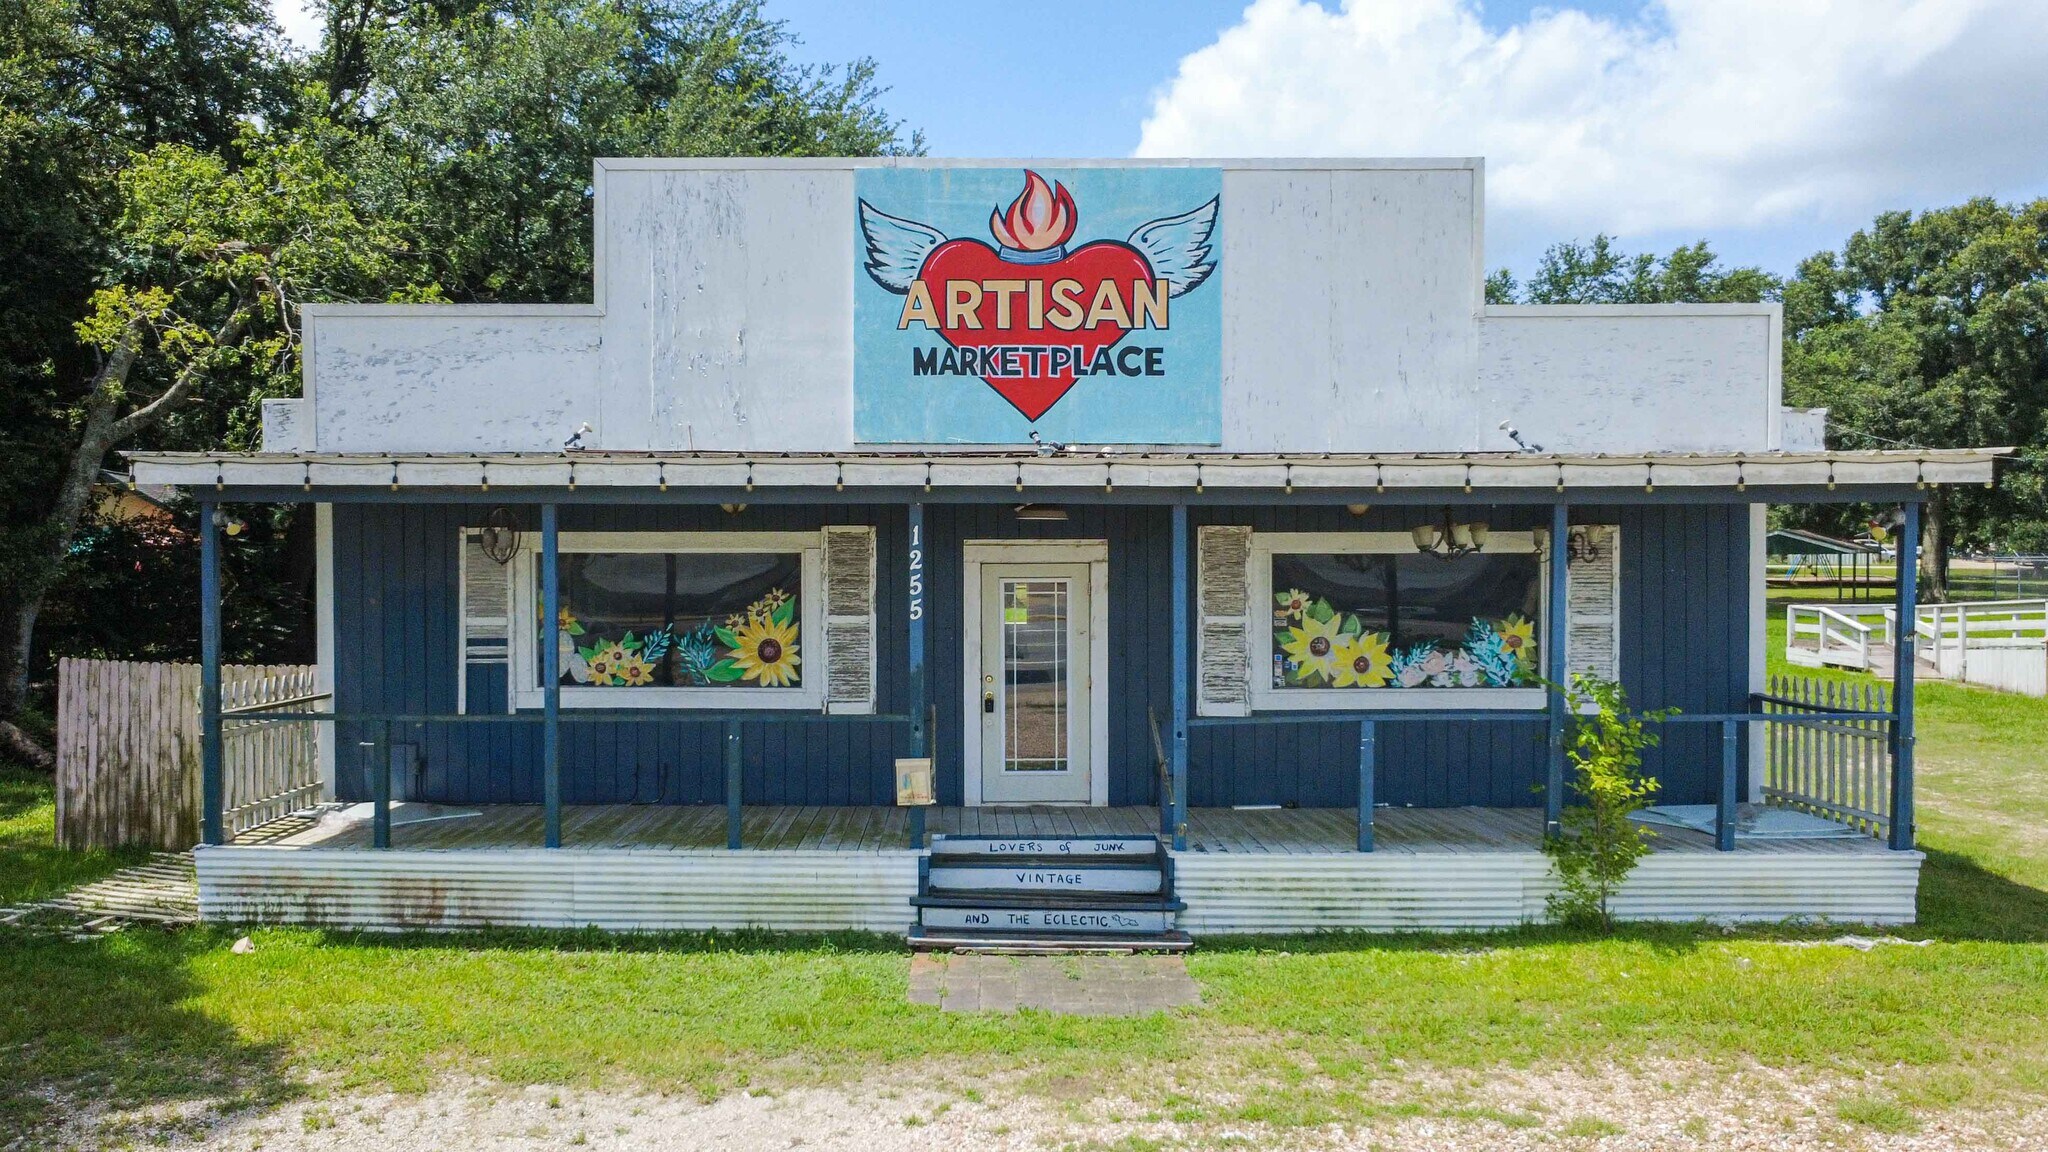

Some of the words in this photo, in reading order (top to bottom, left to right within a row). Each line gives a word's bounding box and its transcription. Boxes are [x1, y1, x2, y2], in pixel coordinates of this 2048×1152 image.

[897, 278, 1170, 331] ARTISAN
[913, 346, 1165, 377] MARKETPLACE
[909, 525, 923, 620] 1255
[989, 841, 1043, 852] LOVERS
[1094, 842, 1125, 852] JUNK
[1016, 873, 1082, 884] VINTAGE
[965, 914, 990, 924] AND
[1008, 914, 1030, 925] THE
